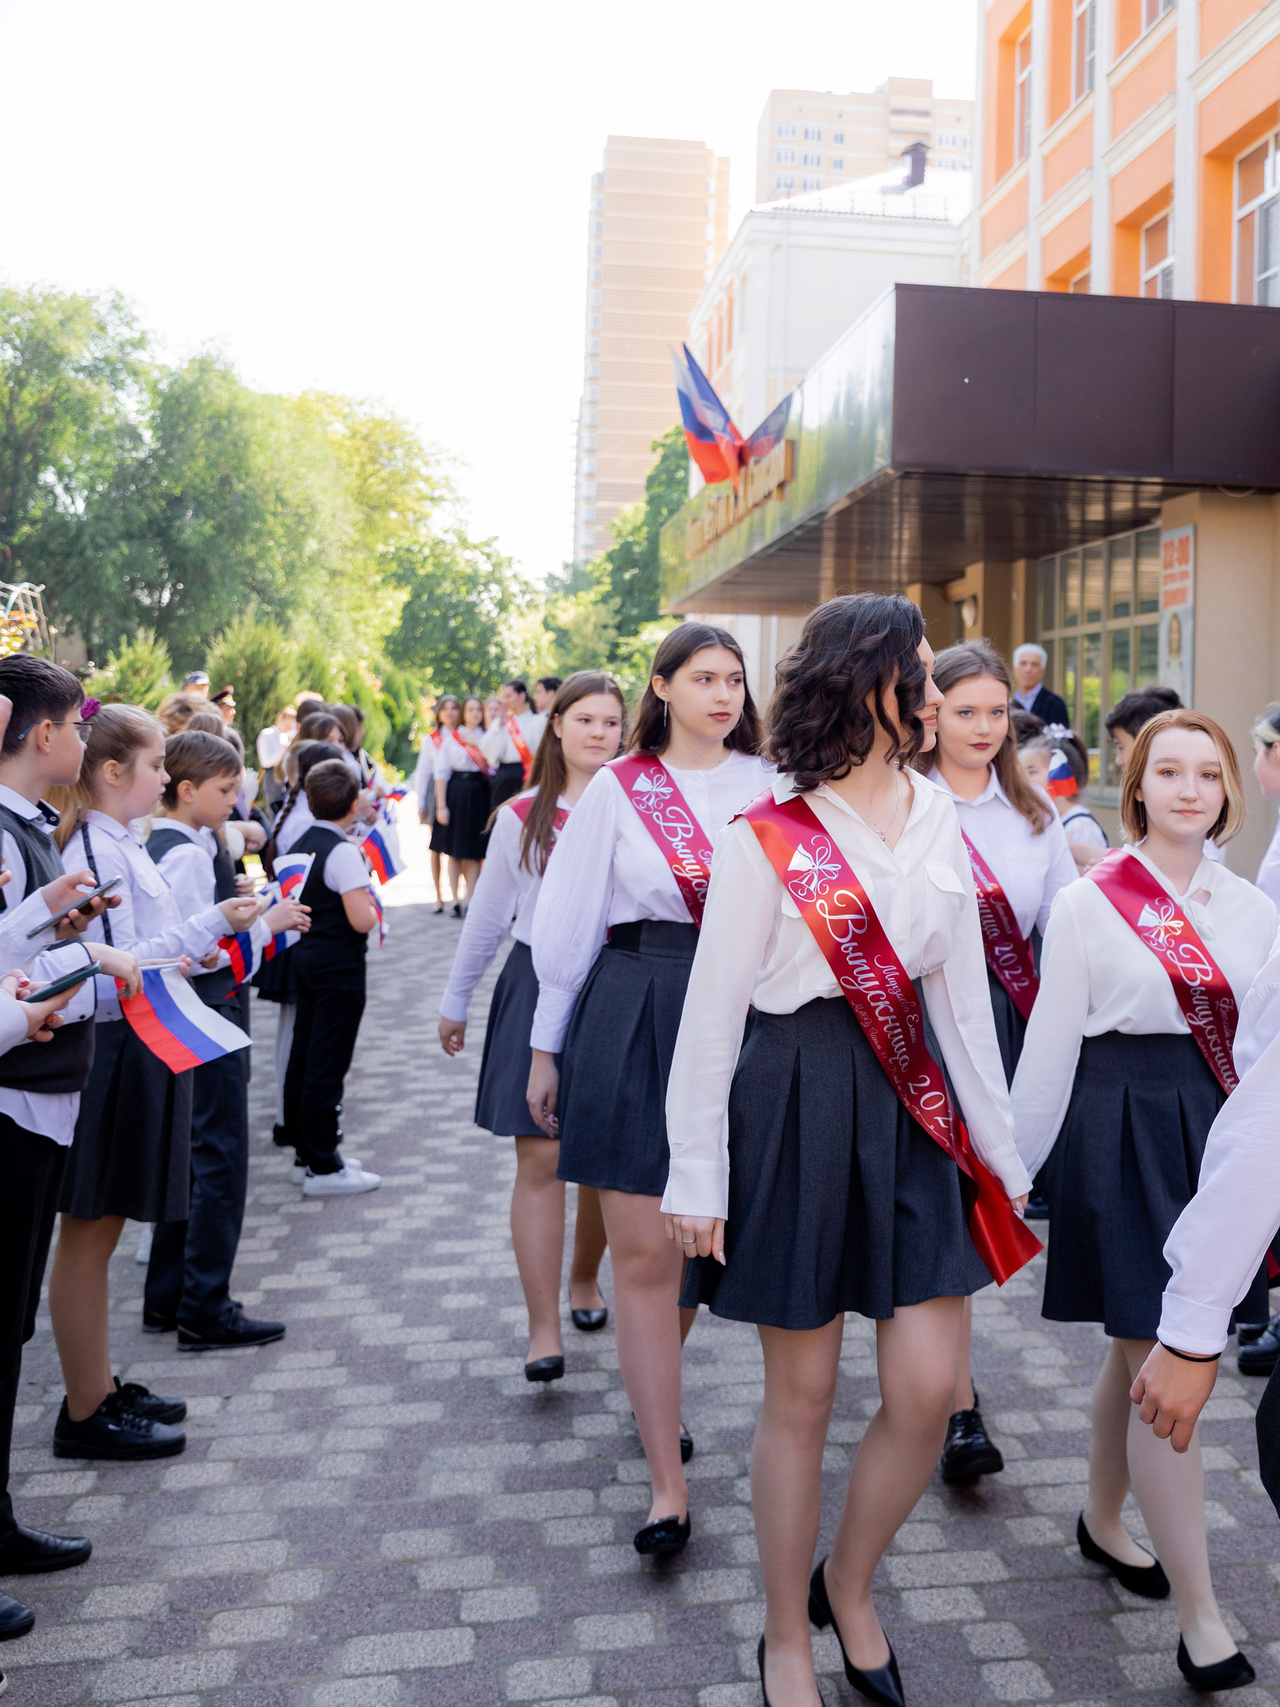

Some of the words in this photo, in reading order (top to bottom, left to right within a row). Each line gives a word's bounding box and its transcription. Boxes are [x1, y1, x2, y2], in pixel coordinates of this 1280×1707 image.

[652, 805, 709, 903] Выпуск
[816, 889, 909, 1073] Выпускница
[874, 954, 917, 1013] Мирзаева
[906, 1013, 920, 1044] Елена
[994, 942, 1030, 992] 2022
